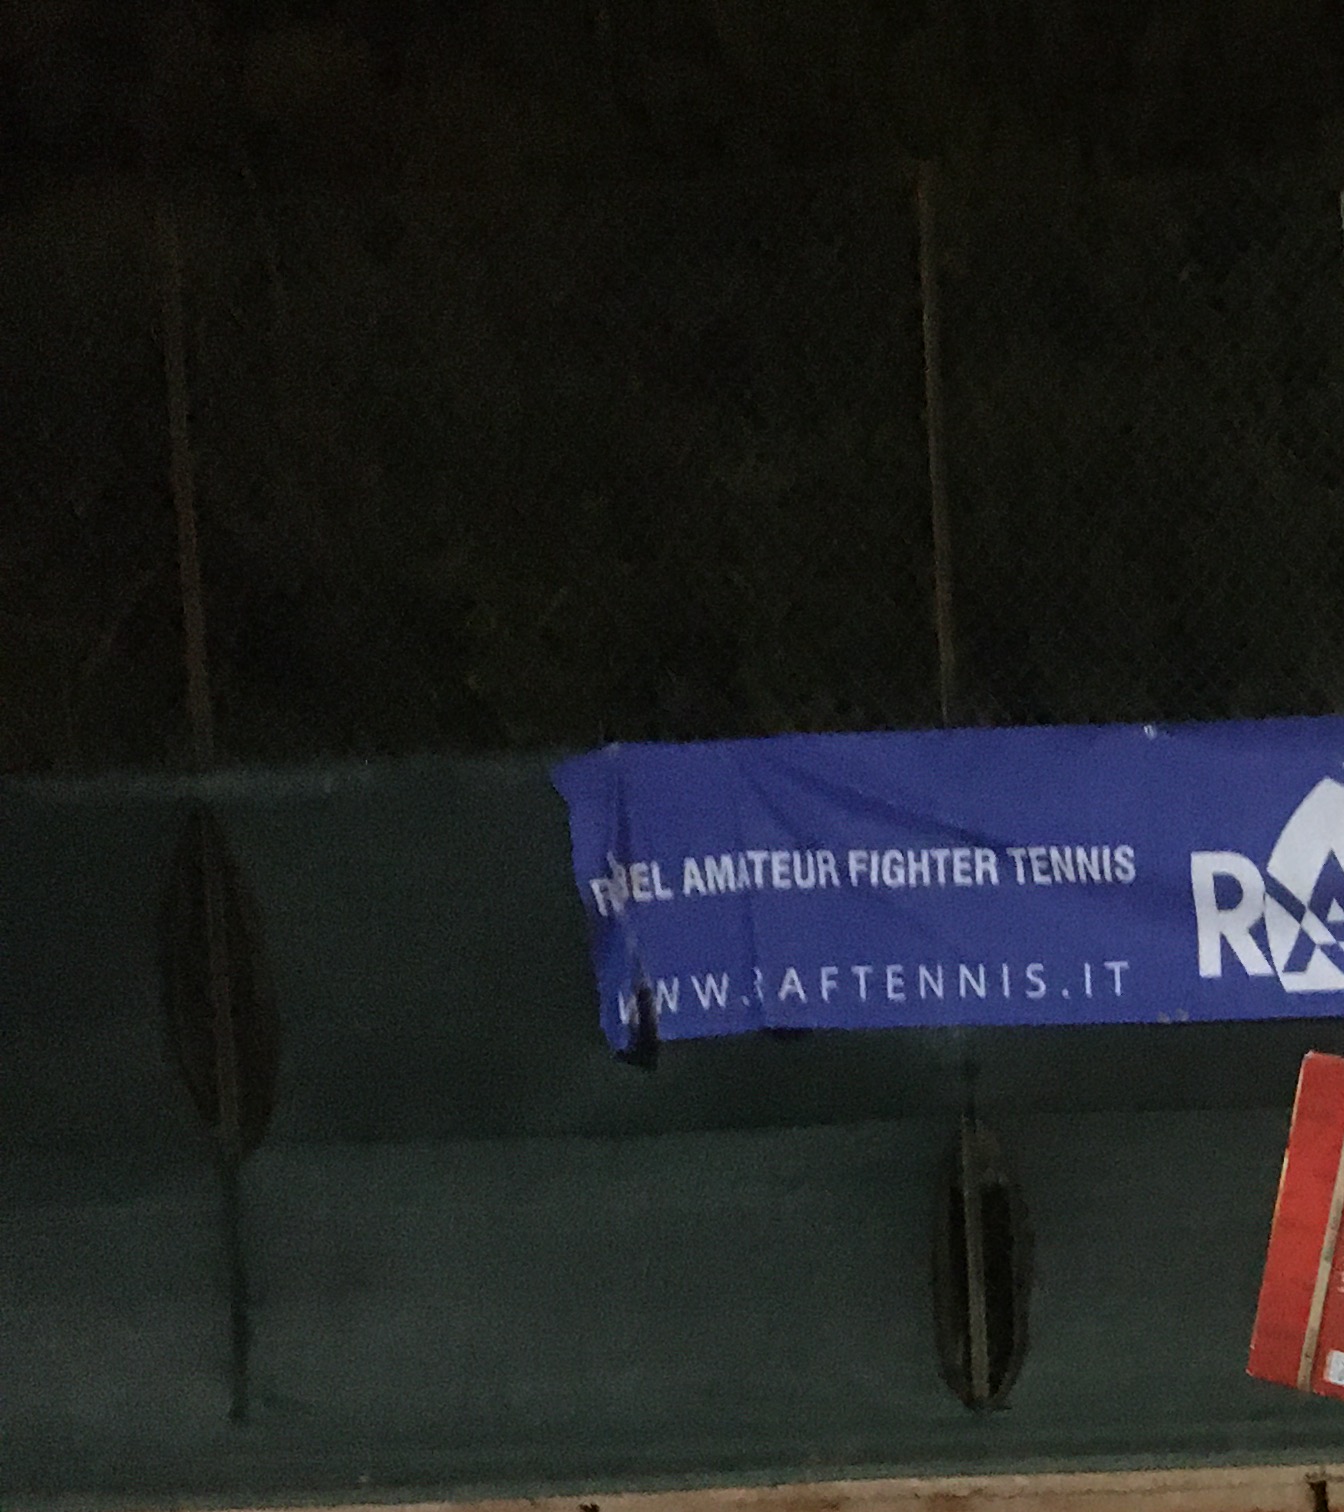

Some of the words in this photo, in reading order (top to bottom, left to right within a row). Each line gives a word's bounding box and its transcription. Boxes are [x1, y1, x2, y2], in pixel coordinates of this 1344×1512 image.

[682, 847, 840, 897] AMATEUR
[847, 845, 1000, 889] FIGHTER
[1007, 843, 1137, 887] TENNIS
